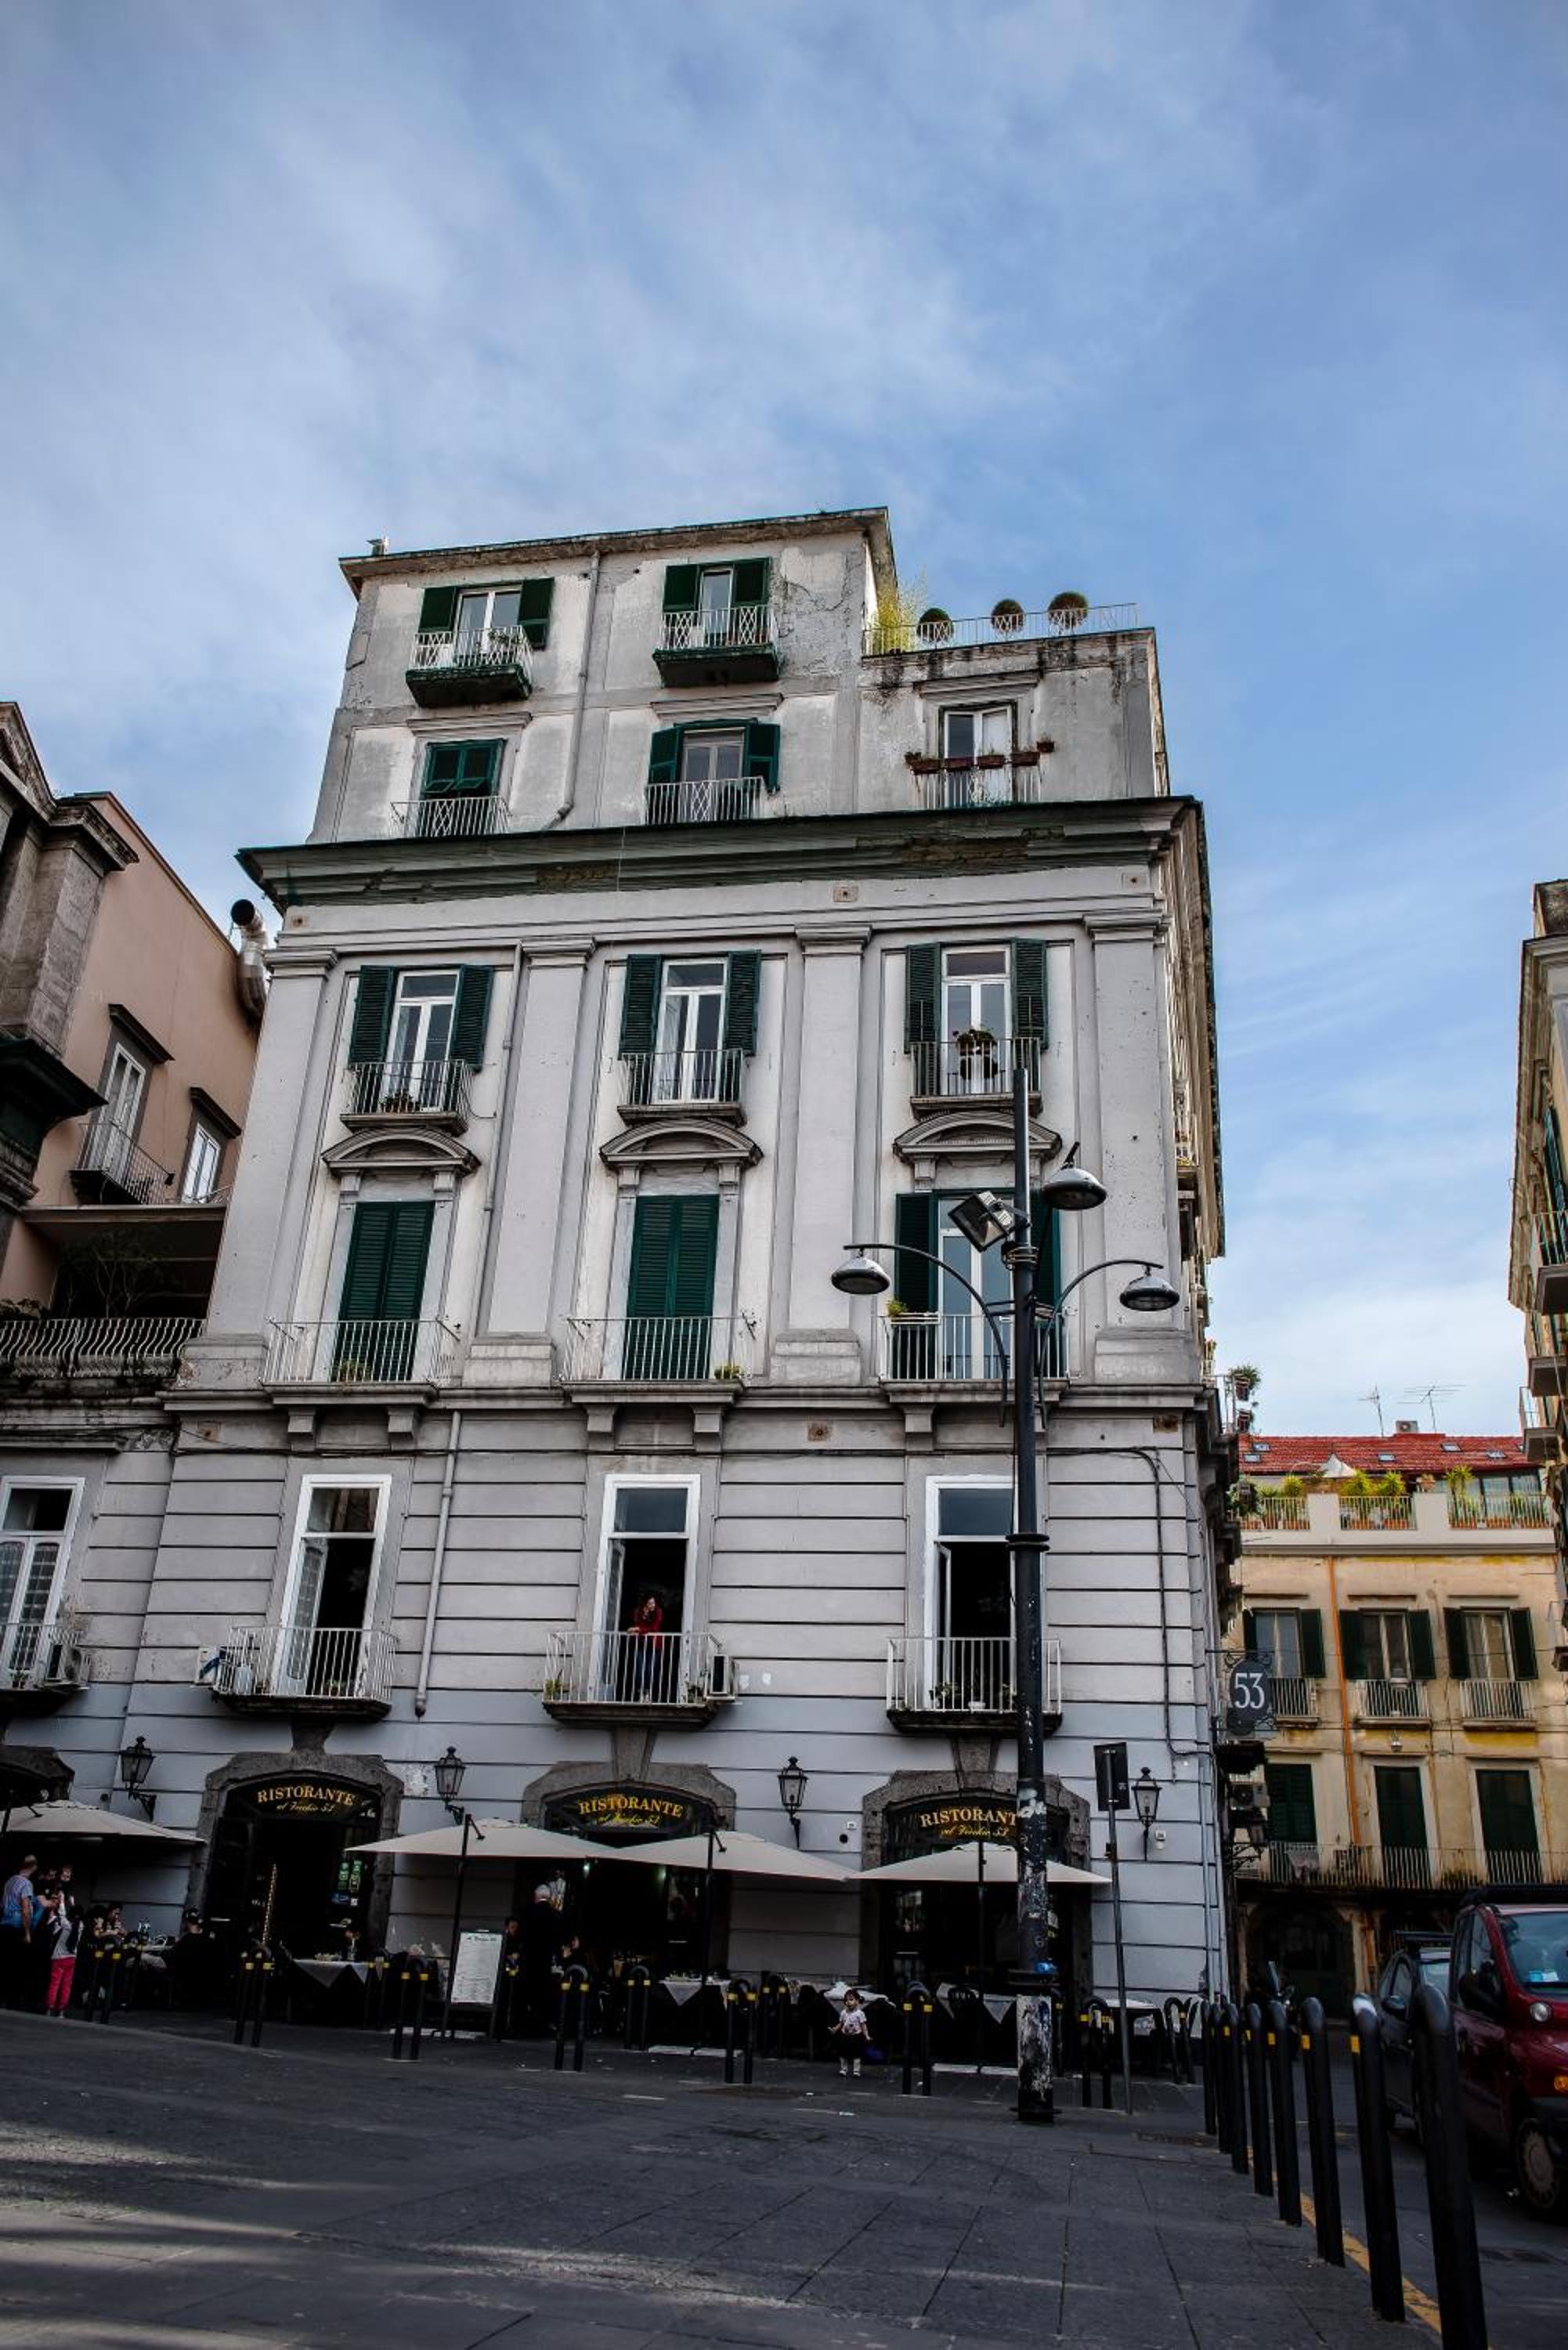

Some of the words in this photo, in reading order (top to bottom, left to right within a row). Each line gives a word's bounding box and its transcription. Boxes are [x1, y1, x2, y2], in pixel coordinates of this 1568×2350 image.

[1234, 1672, 1265, 1709] 53
[257, 1785, 356, 1806] RISTORANTE
[577, 1795, 684, 1817] RISTORANTE
[919, 1808, 1017, 1828] RISTORANT
